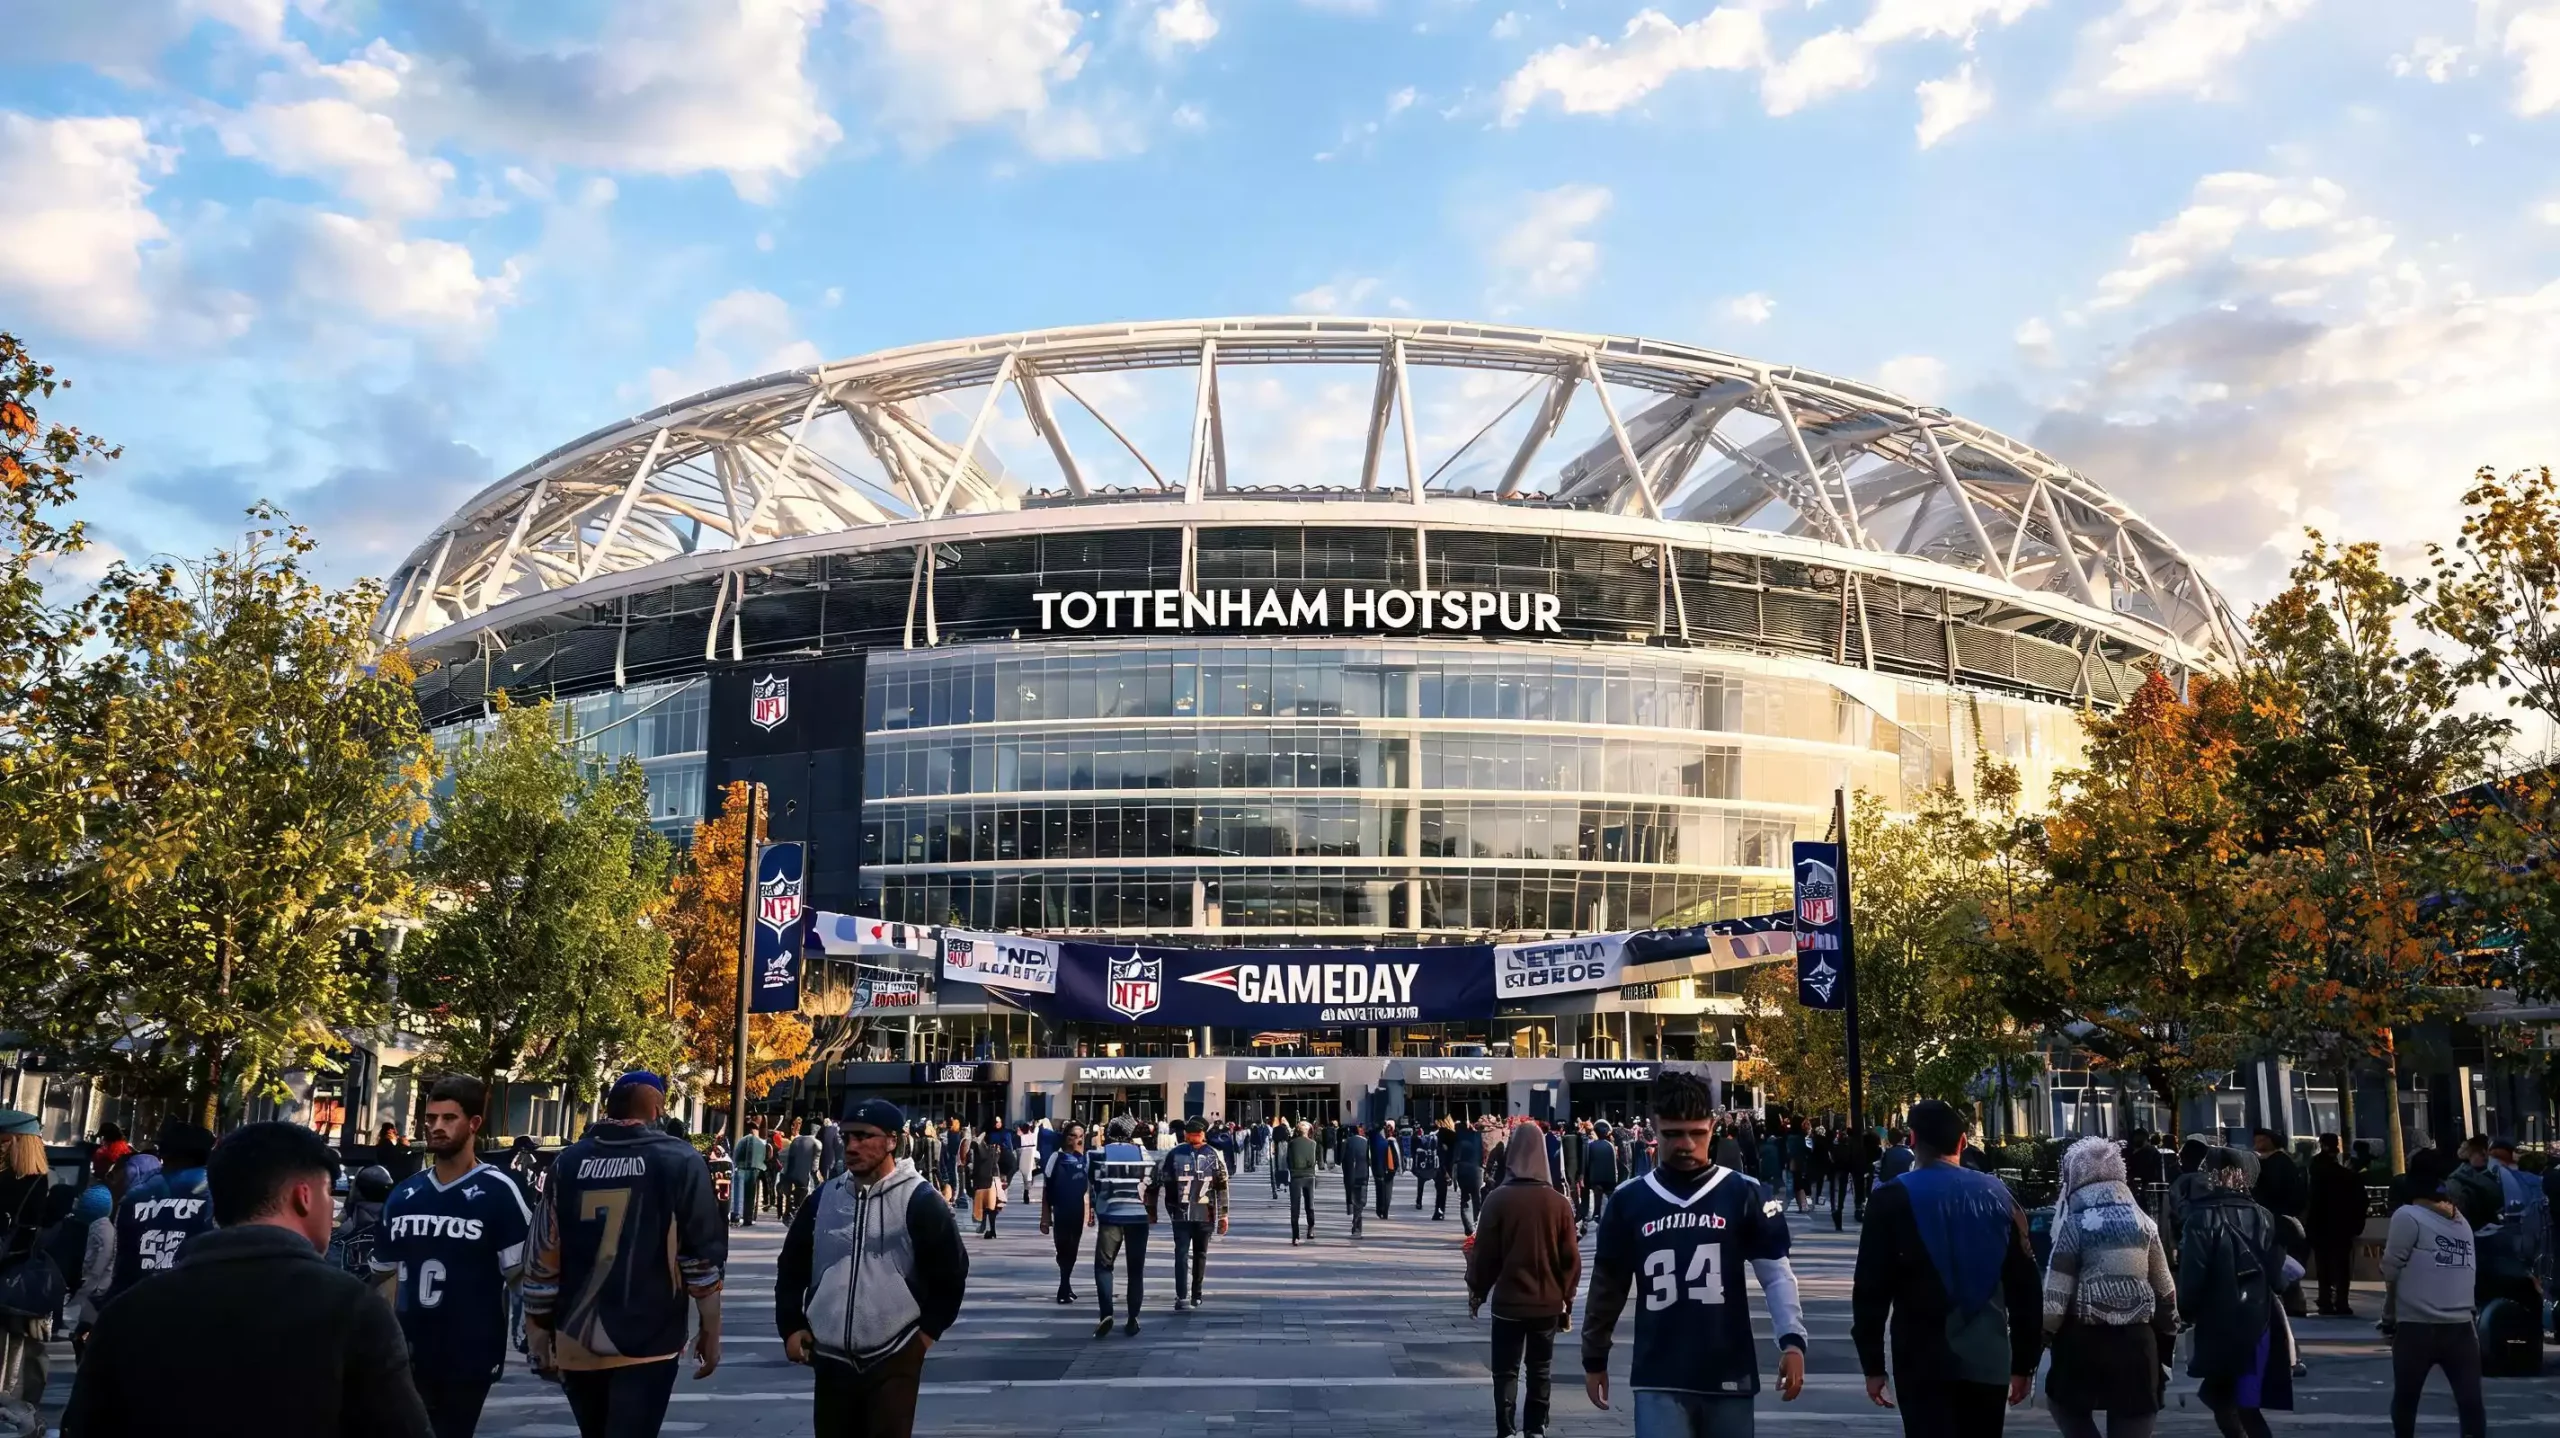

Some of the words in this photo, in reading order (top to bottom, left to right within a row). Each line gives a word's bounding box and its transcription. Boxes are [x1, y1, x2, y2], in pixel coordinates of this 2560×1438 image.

[1033, 588, 1328, 629] TOTTENHAM
[1344, 588, 1562, 633] HOTSPUR
[764, 897, 796, 923] NFL
[1115, 981, 1155, 1010] NFL
[1237, 963, 1420, 1004] GAMEDAY
[1643, 1242, 1725, 1312] 34
